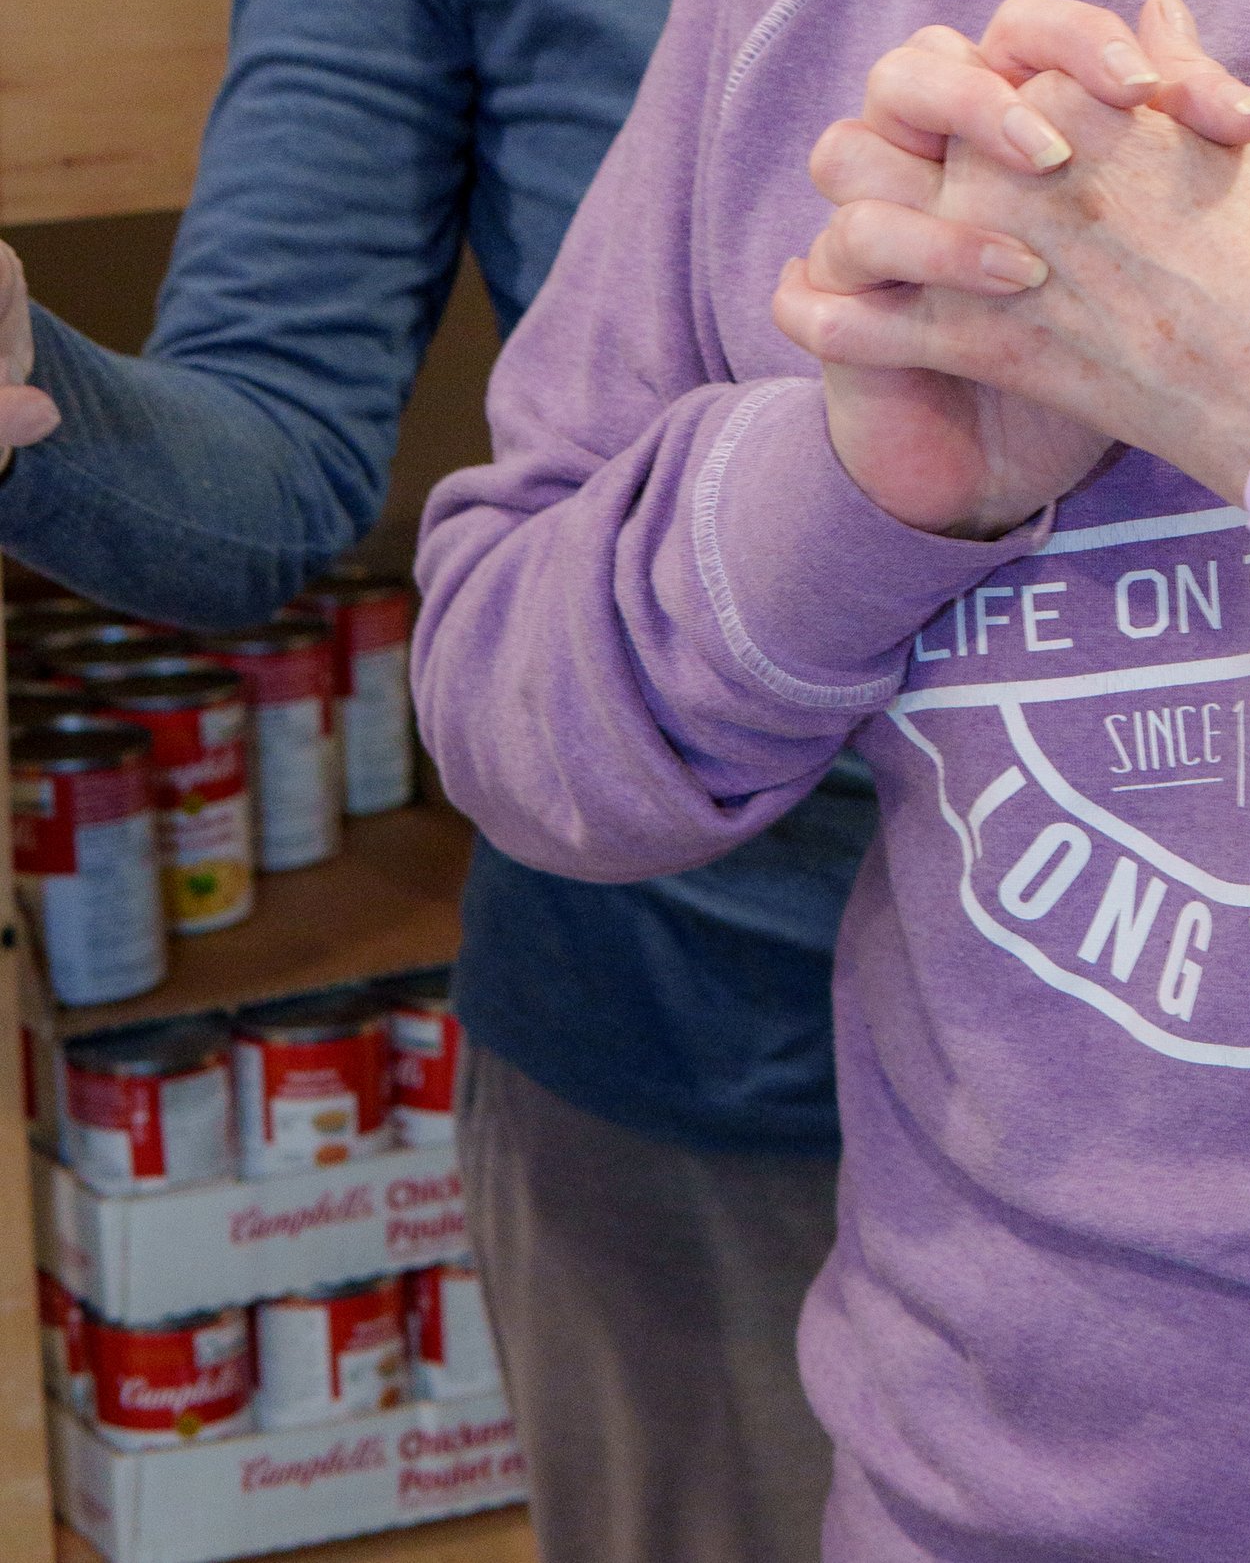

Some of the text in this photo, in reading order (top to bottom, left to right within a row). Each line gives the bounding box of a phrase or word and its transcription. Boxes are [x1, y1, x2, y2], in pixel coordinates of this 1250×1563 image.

[1115, 559, 1223, 639] ON
[1104, 701, 1222, 774] SINCE
[967, 765, 1213, 1023] LONG
